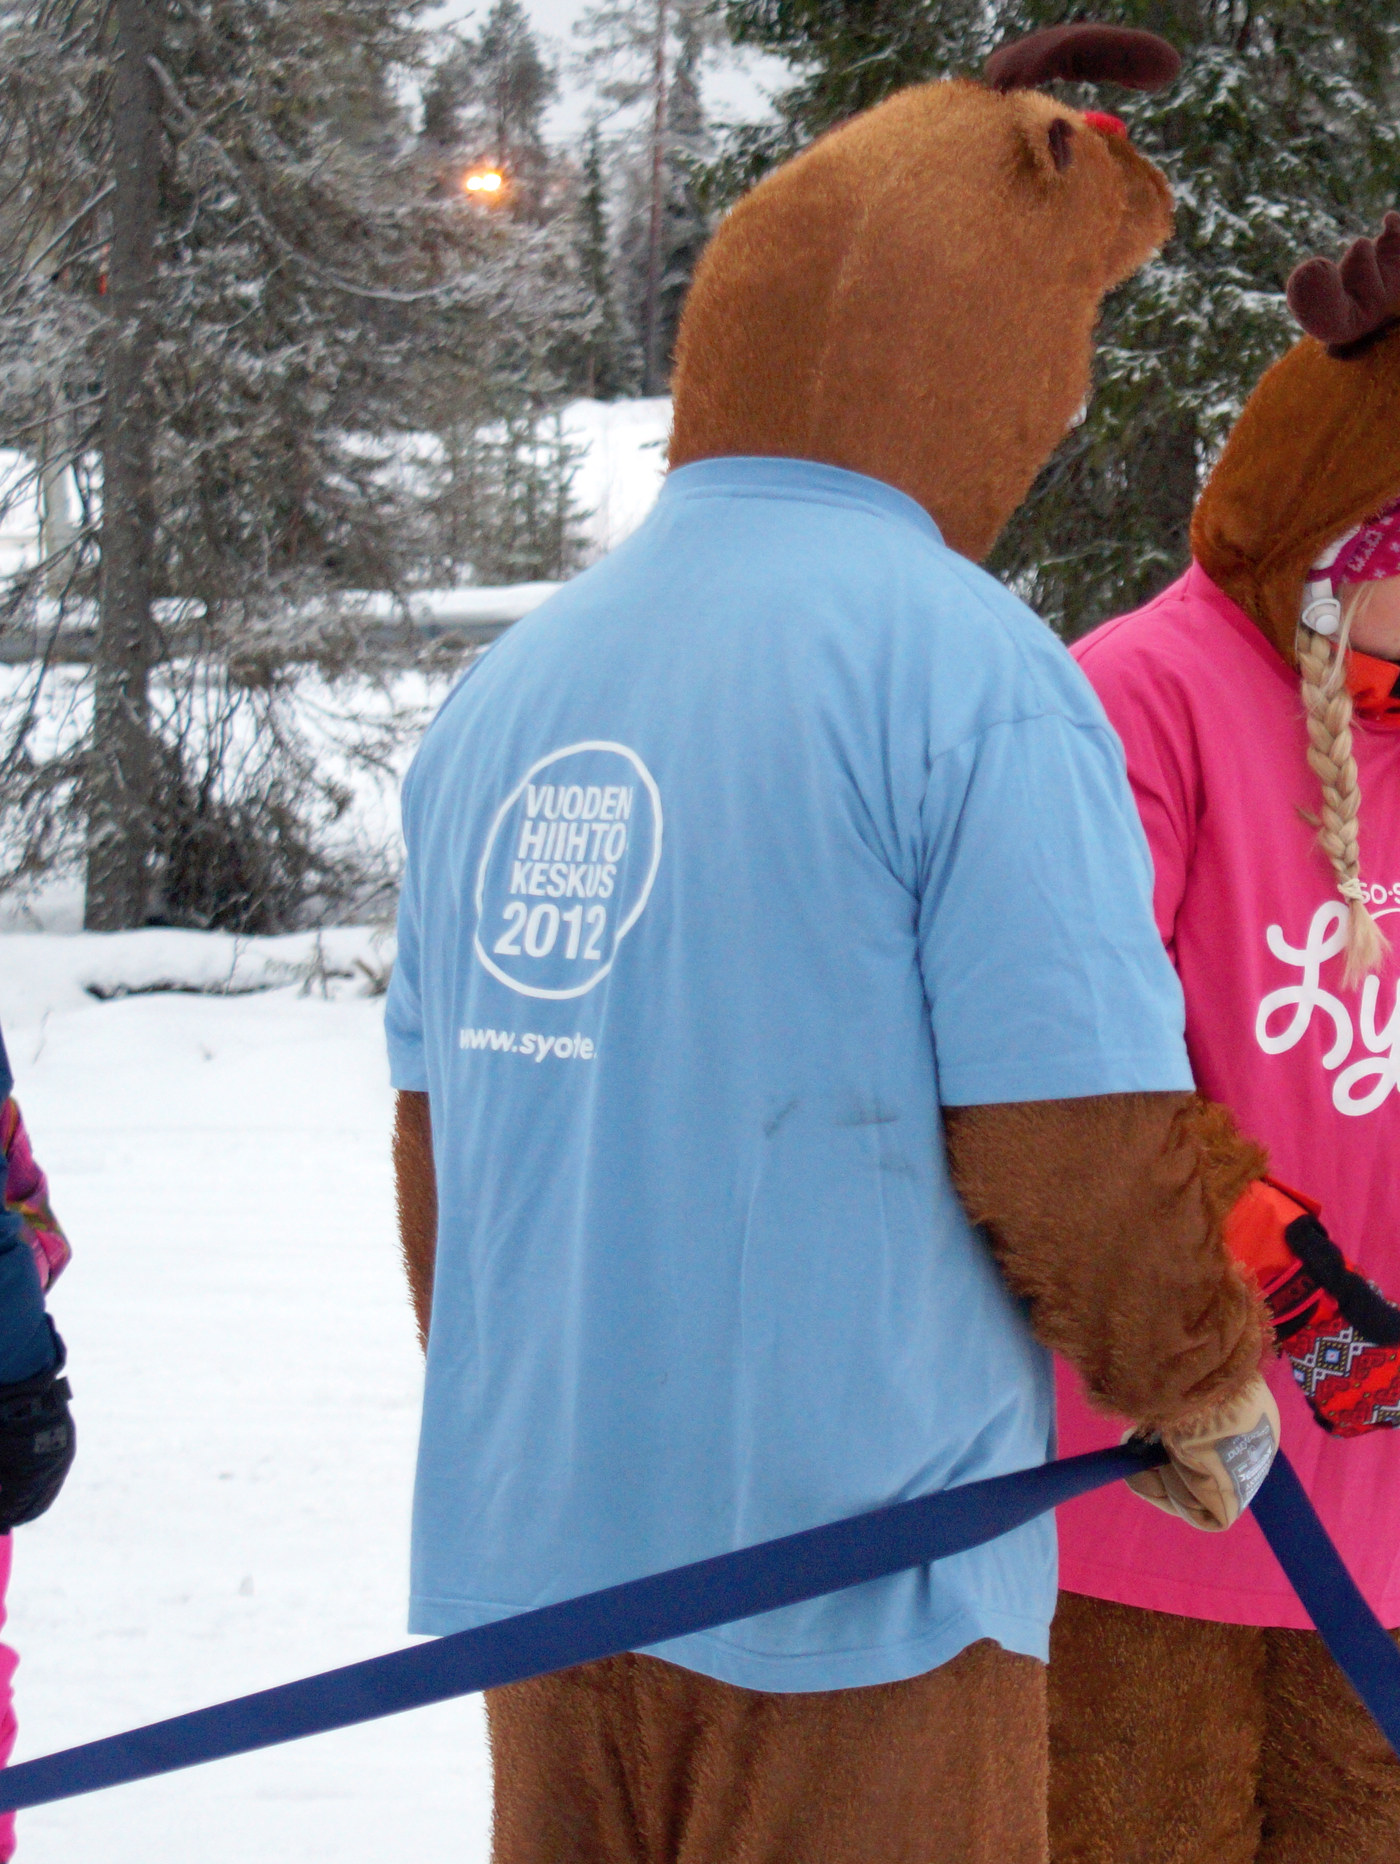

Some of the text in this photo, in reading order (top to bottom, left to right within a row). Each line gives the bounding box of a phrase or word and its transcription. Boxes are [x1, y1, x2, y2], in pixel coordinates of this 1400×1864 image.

[527, 784, 633, 820] VUODEN
[518, 820, 627, 863] HIIHTO
[510, 860, 617, 898] KESKUS
[494, 901, 607, 960] 2012
